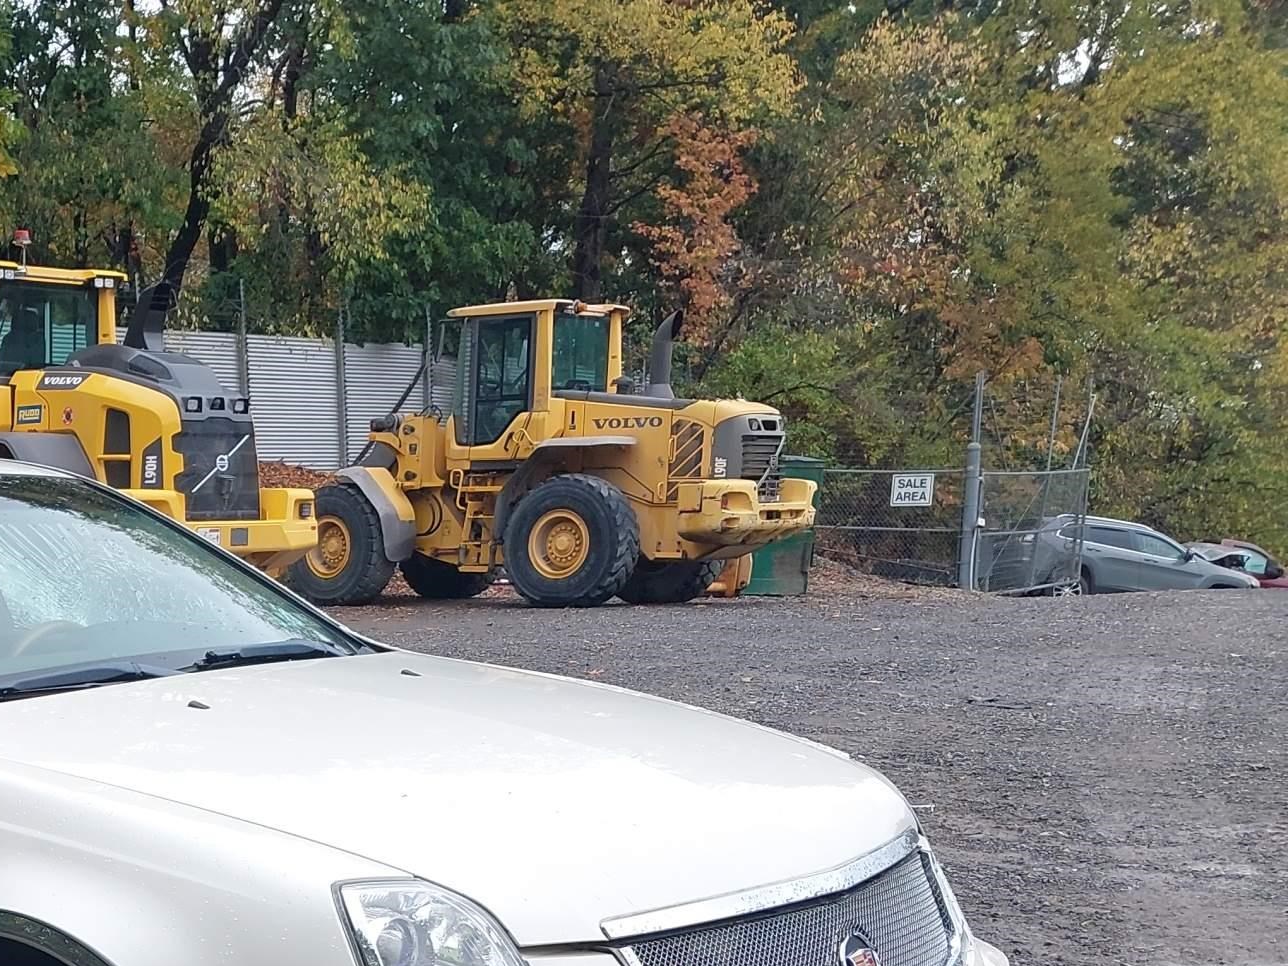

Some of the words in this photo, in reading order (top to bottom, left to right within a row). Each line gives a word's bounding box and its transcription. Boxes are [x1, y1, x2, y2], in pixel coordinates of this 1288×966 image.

[44, 376, 83, 385] VOLVO
[592, 416, 663, 430] VOLVO
[144, 455, 157, 484] L90H
[713, 456, 728, 478] L90F
[897, 478, 928, 489] SALE
[895, 491, 927, 502] AREA
